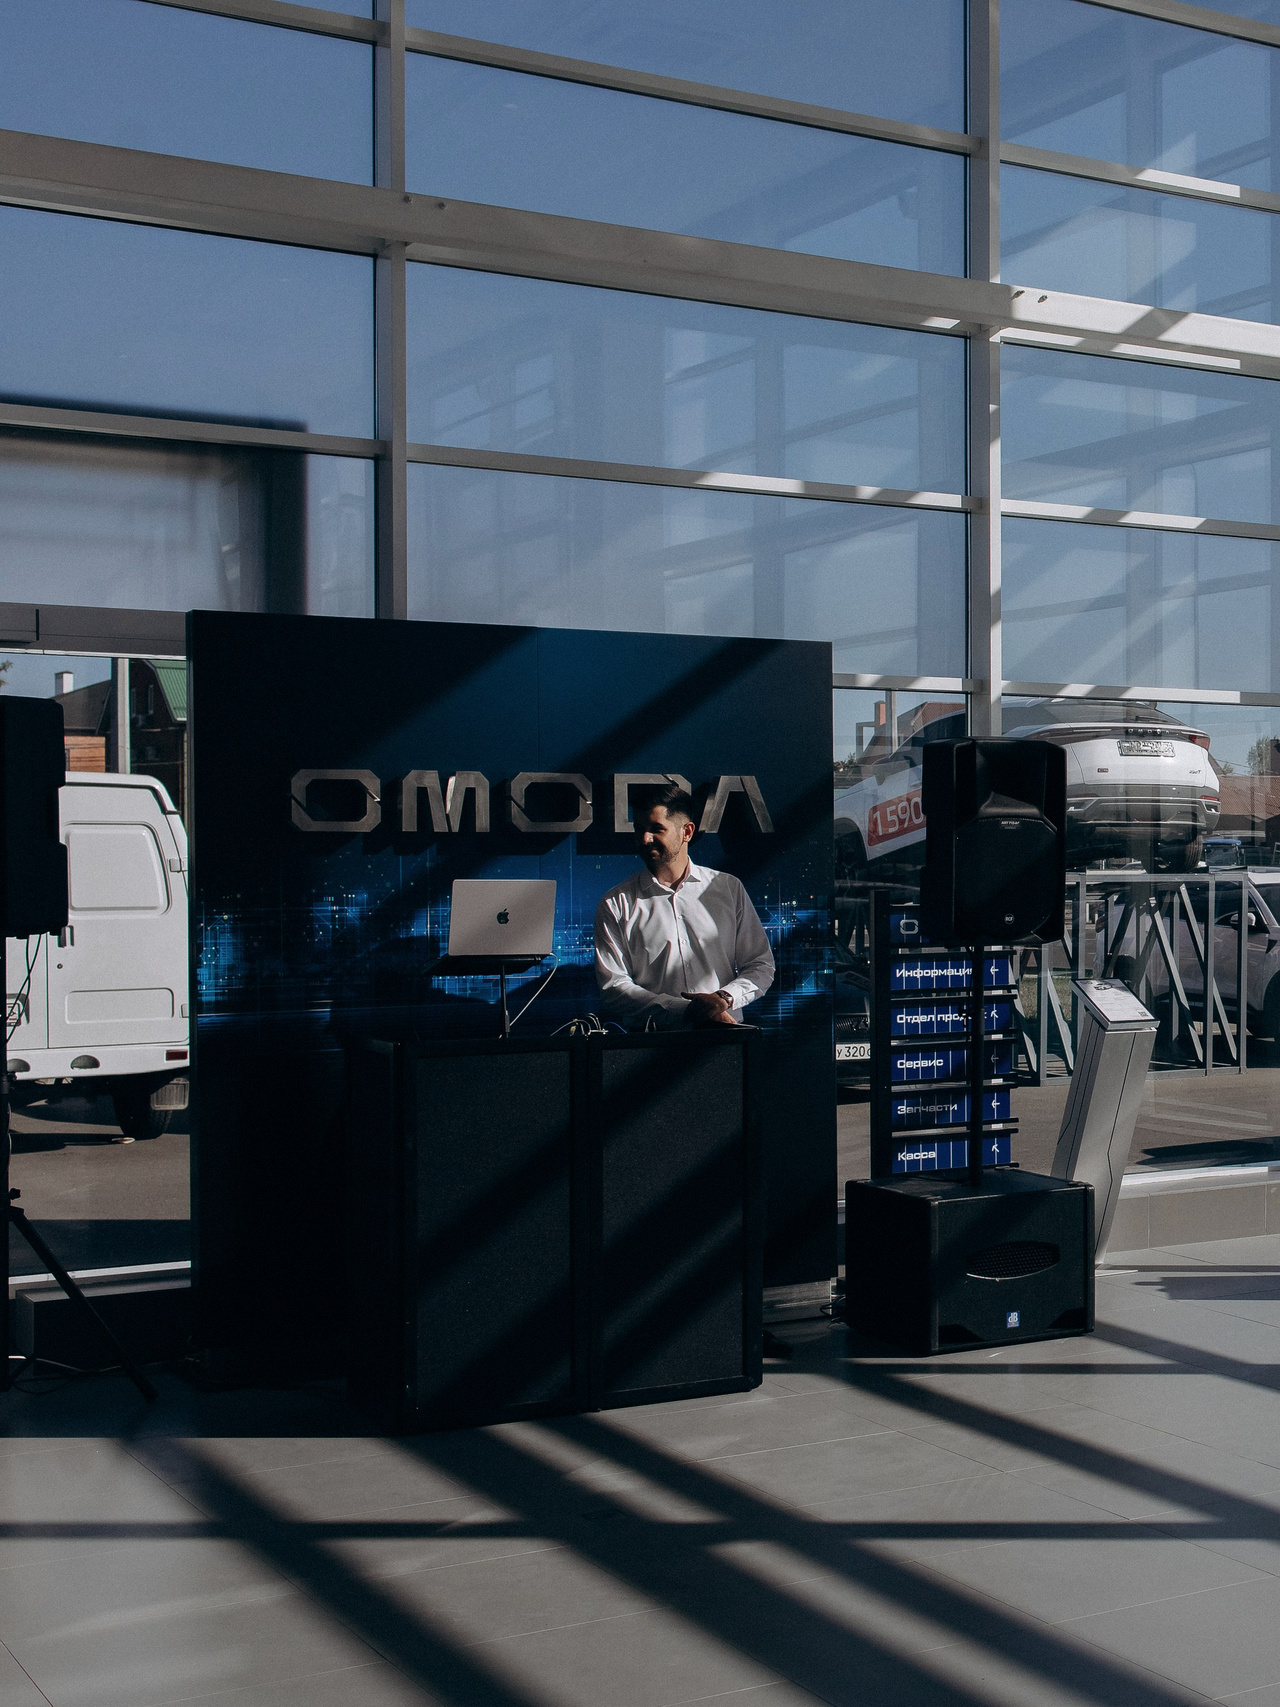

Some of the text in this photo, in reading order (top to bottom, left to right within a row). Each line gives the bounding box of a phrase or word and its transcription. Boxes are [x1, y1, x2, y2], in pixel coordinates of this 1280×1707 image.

[289, 769, 776, 835] OMODA
[896, 1013, 935, 1024] Отдел
[896, 1057, 944, 1070] Сервис
[896, 1101, 958, 1116] Запчасти
[897, 1149, 937, 1161] Касса
